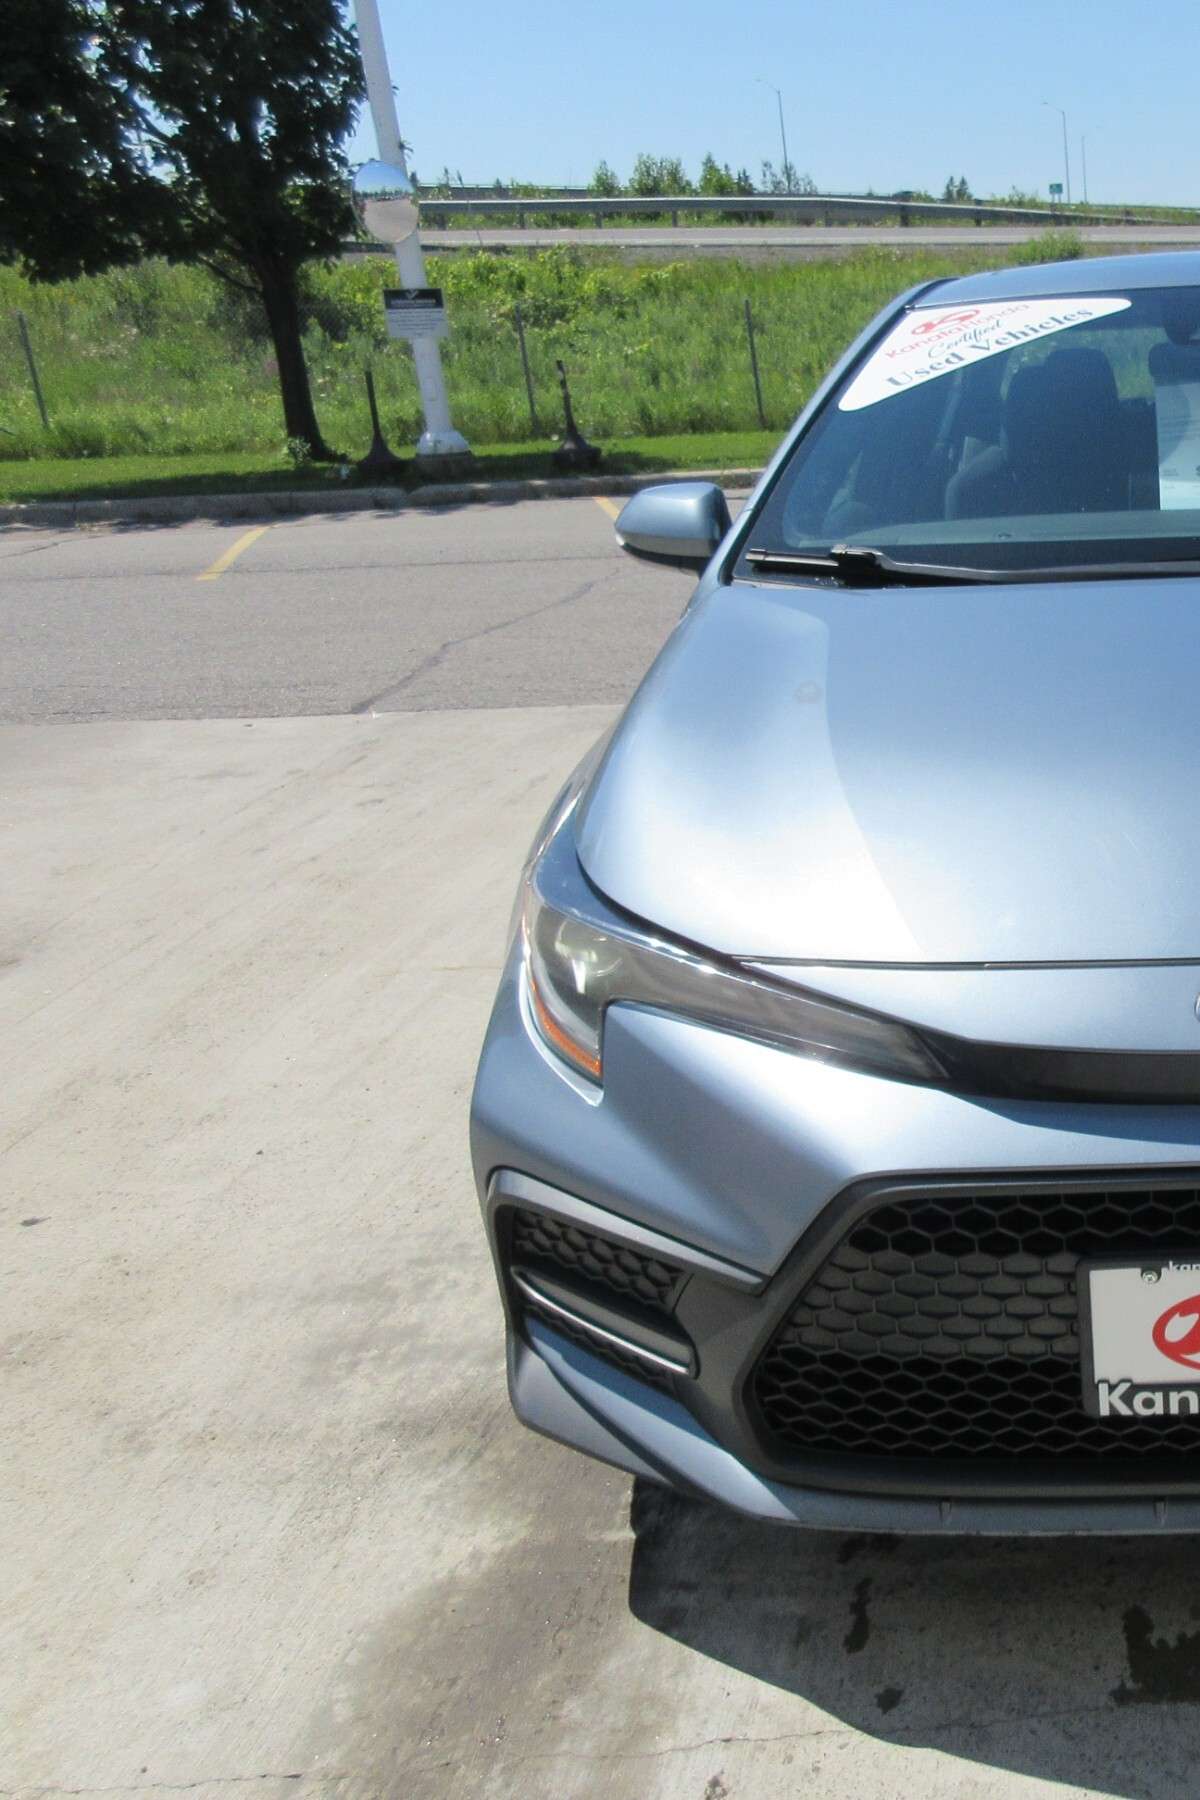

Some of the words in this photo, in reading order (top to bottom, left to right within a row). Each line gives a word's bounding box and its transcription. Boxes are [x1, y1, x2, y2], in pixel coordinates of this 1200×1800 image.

[885, 352, 965, 387] Used
[970, 308, 1093, 351] Vehicles
[928, 318, 1001, 359] Certified
